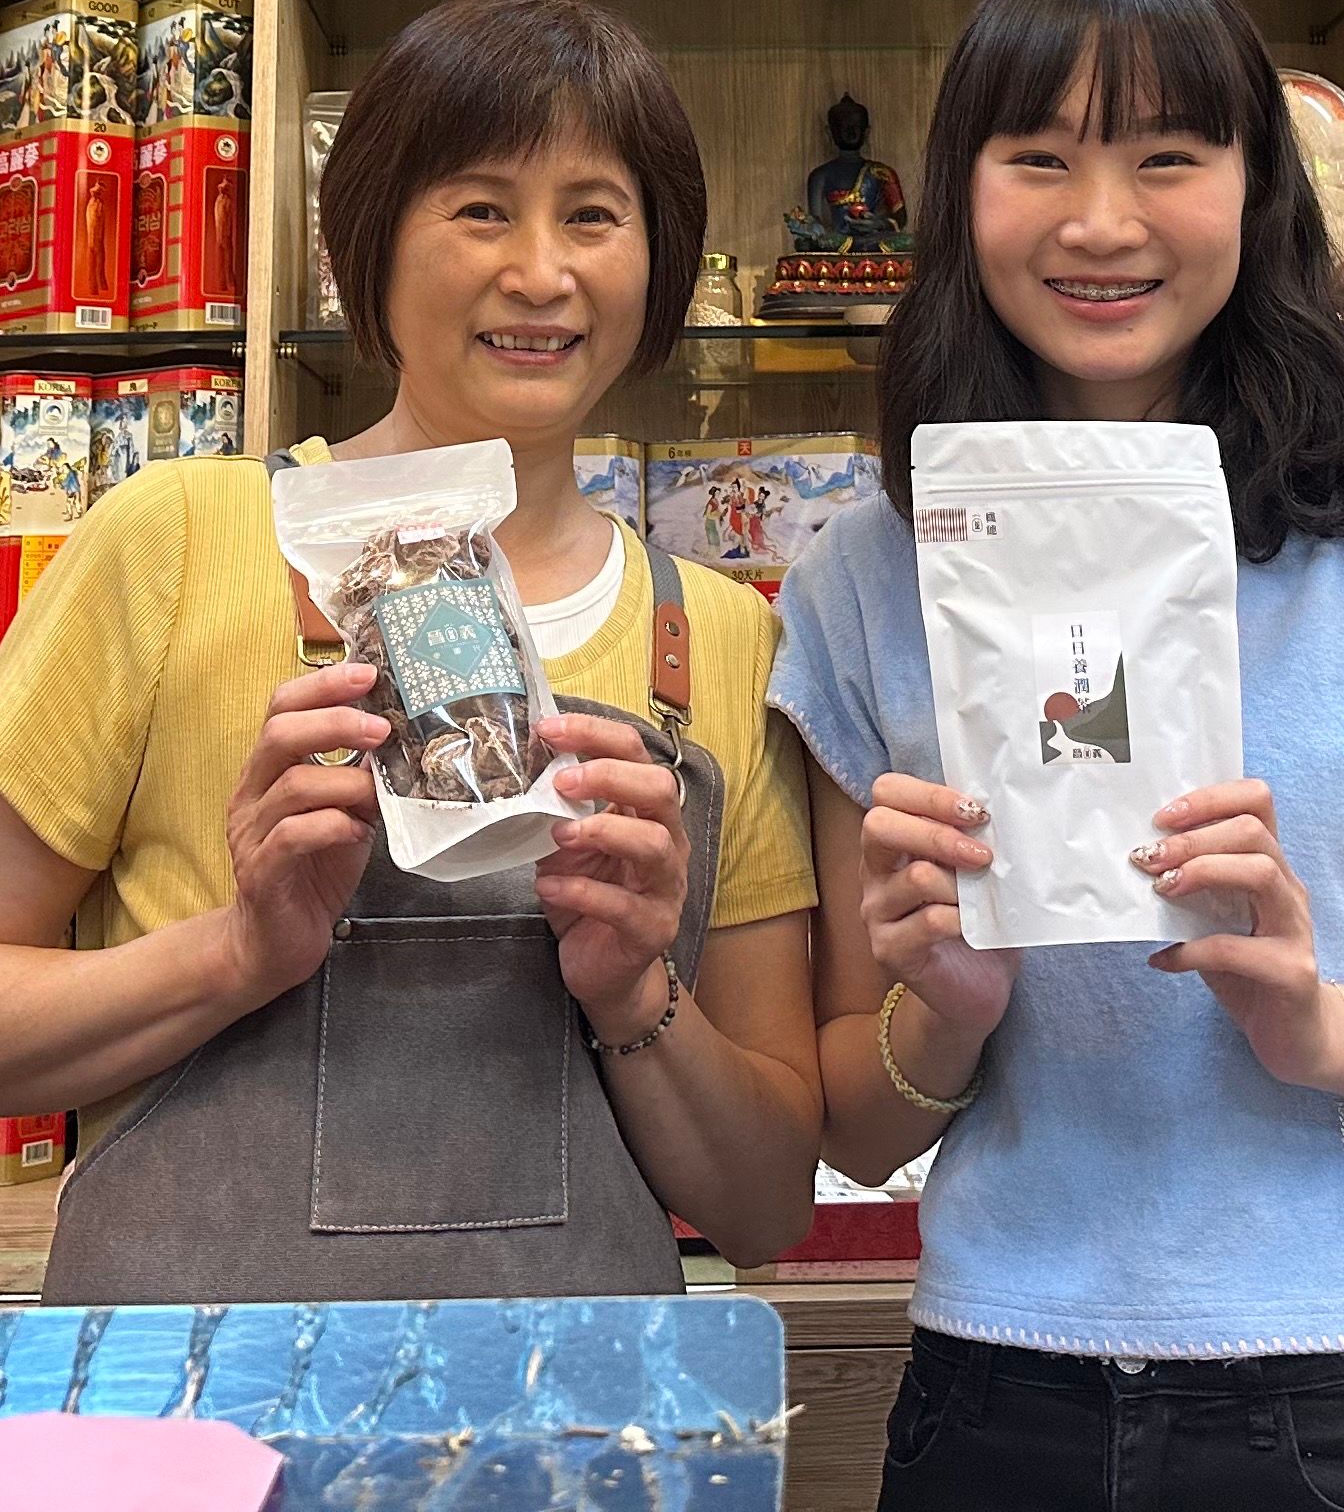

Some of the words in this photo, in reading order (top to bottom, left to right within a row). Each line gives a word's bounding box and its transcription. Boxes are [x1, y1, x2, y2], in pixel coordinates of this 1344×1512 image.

[88, 0, 119, 15] GOOD
[93, 121, 107, 133] 20
[36, 380, 74, 394] KOREA
